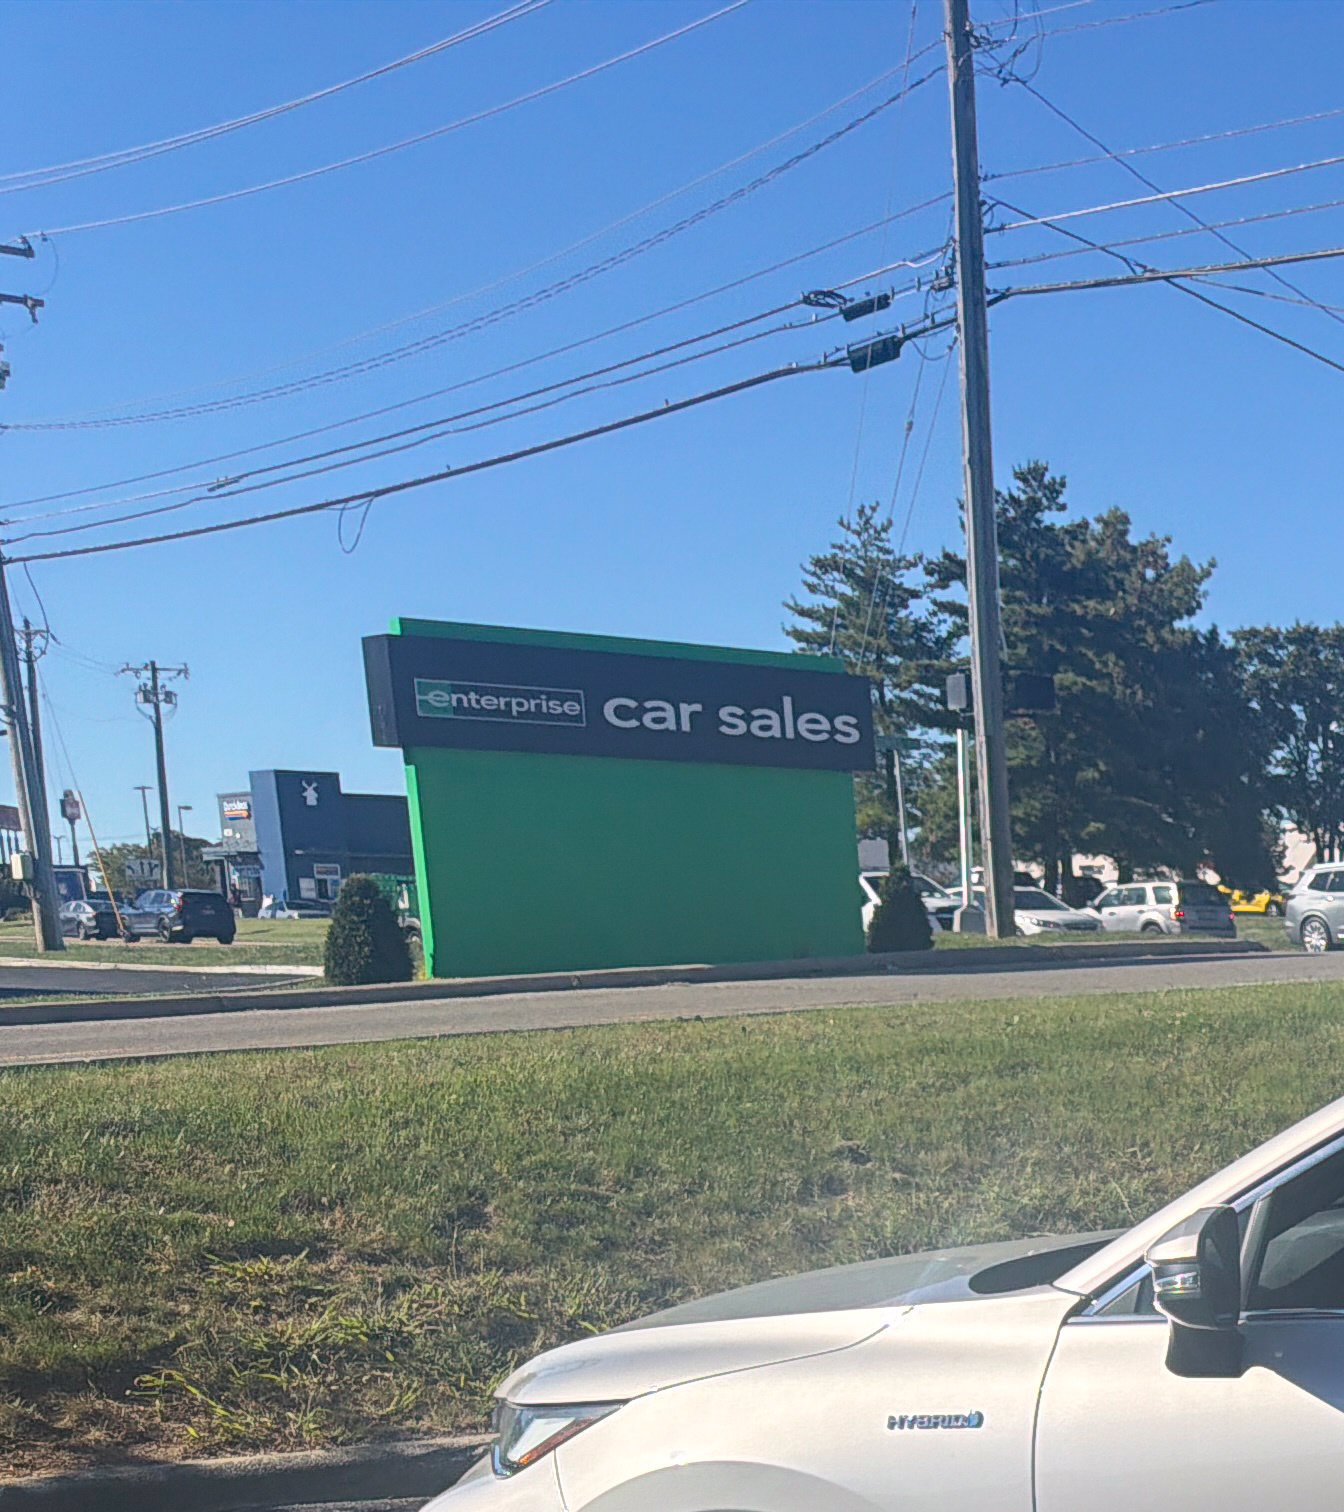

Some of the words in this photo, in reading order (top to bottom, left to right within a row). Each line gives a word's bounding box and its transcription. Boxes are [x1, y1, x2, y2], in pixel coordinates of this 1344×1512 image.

[426, 689, 581, 716] enterprise
[602, 697, 703, 732] car
[718, 695, 861, 744] sales
